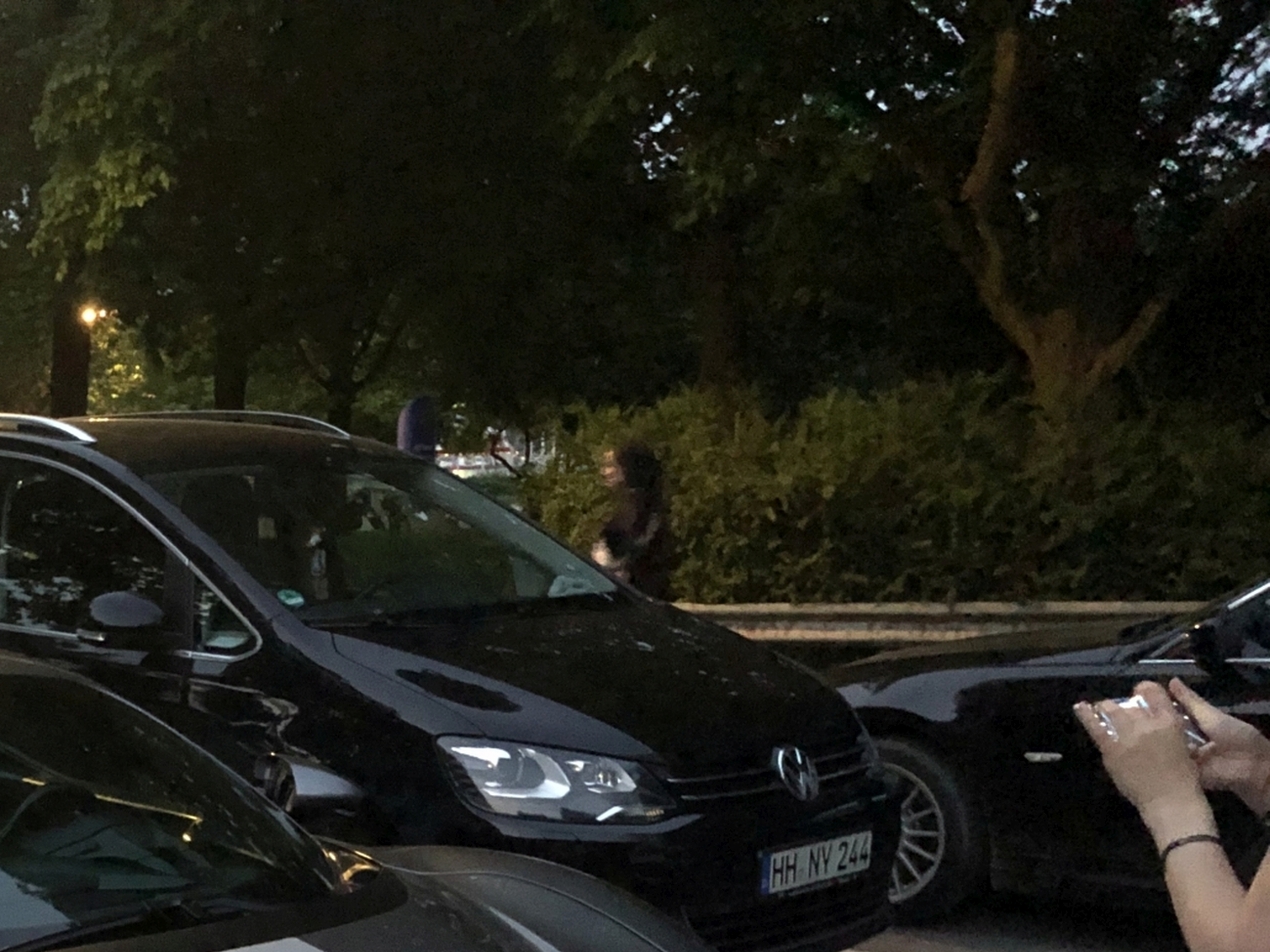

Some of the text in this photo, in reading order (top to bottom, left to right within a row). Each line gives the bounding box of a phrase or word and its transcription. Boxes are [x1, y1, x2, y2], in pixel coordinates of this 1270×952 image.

[772, 838, 869, 888] HH NY 244
